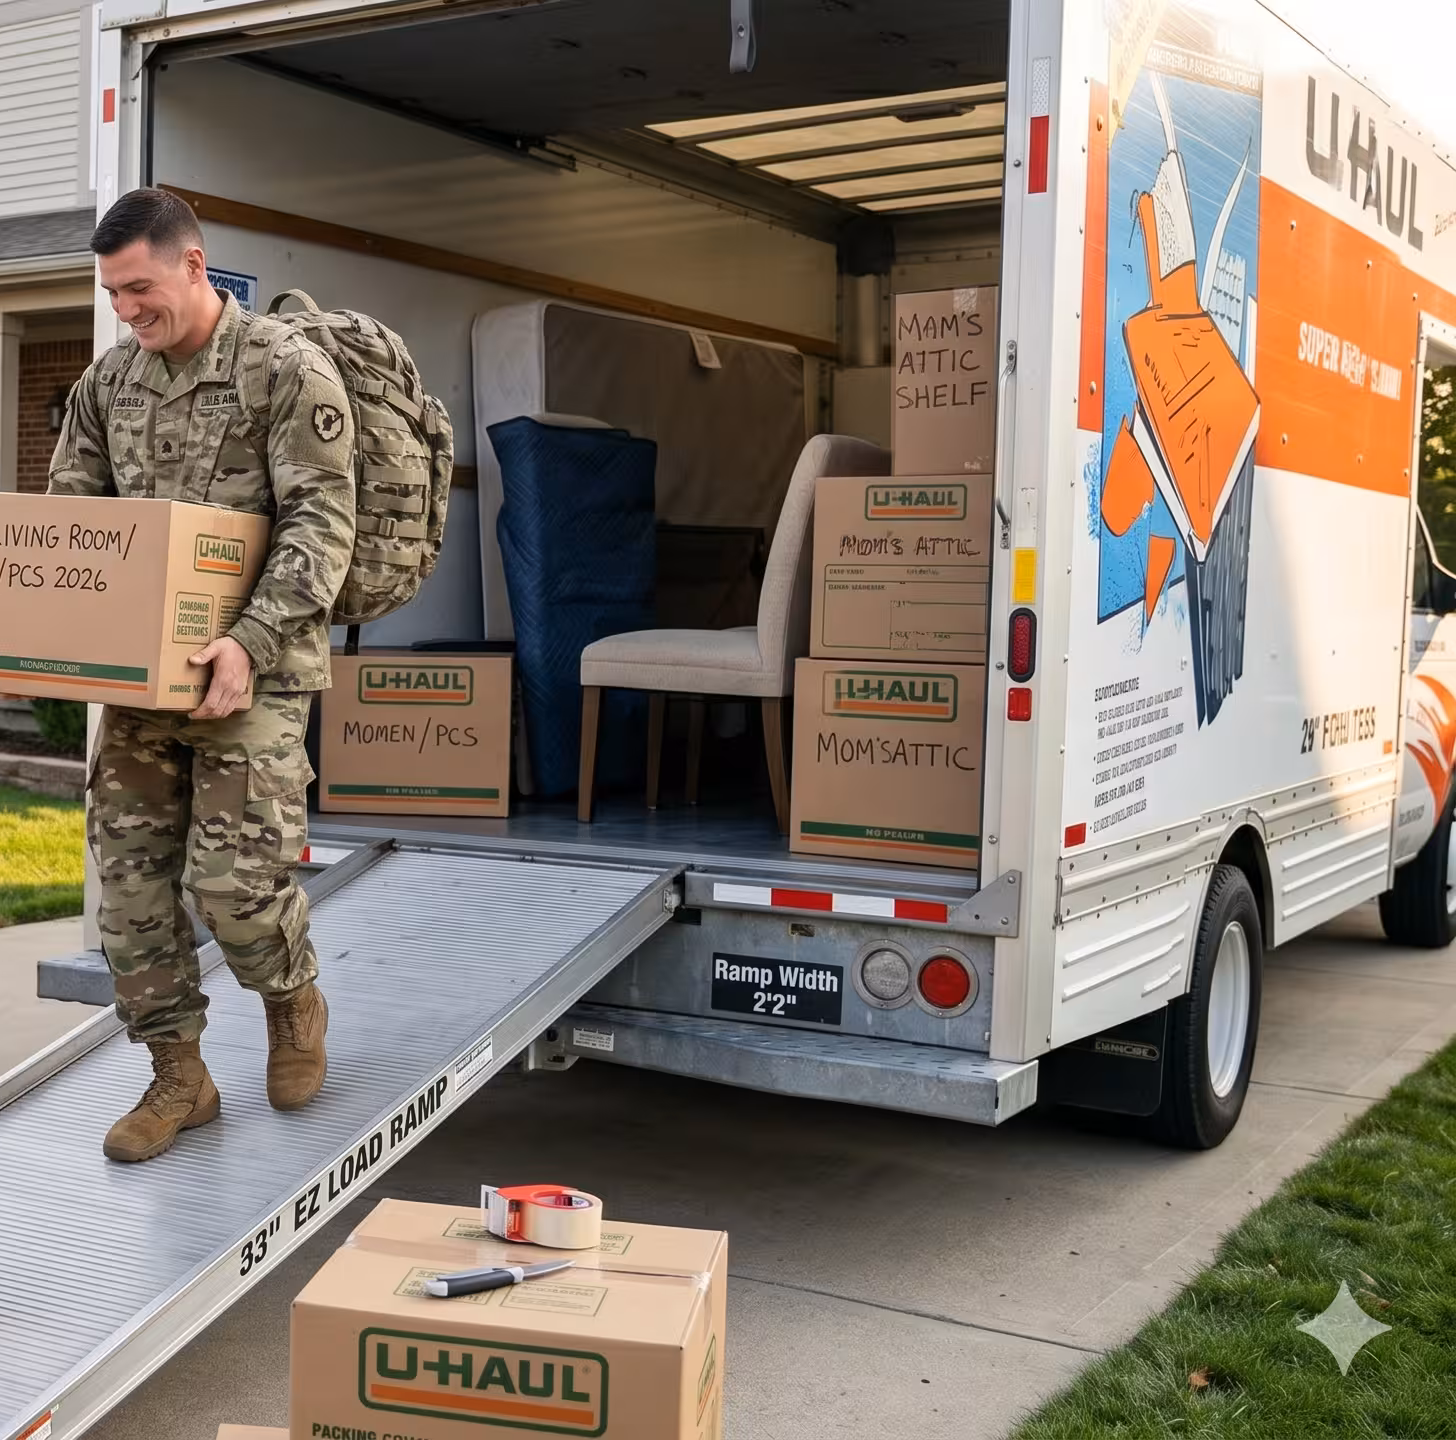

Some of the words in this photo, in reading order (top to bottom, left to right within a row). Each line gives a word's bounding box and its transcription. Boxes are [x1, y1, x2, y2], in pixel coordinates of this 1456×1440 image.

[898, 310, 984, 341] MAM'S
[896, 381, 988, 409] SHELF
[199, 540, 241, 562] U-HAUL
[54, 566, 107, 592] 2026
[366, 671, 467, 690] U-HAUL
[715, 959, 773, 988] Ramp
[779, 965, 838, 992] Width
[753, 991, 797, 1015] 2'2"
[239, 1216, 281, 1277] 33"
[294, 1183, 322, 1232] EZ
[328, 1131, 383, 1203] LOAD
[390, 1075, 448, 1150] RAMP
[376, 1342, 590, 1403] U-HAUL
